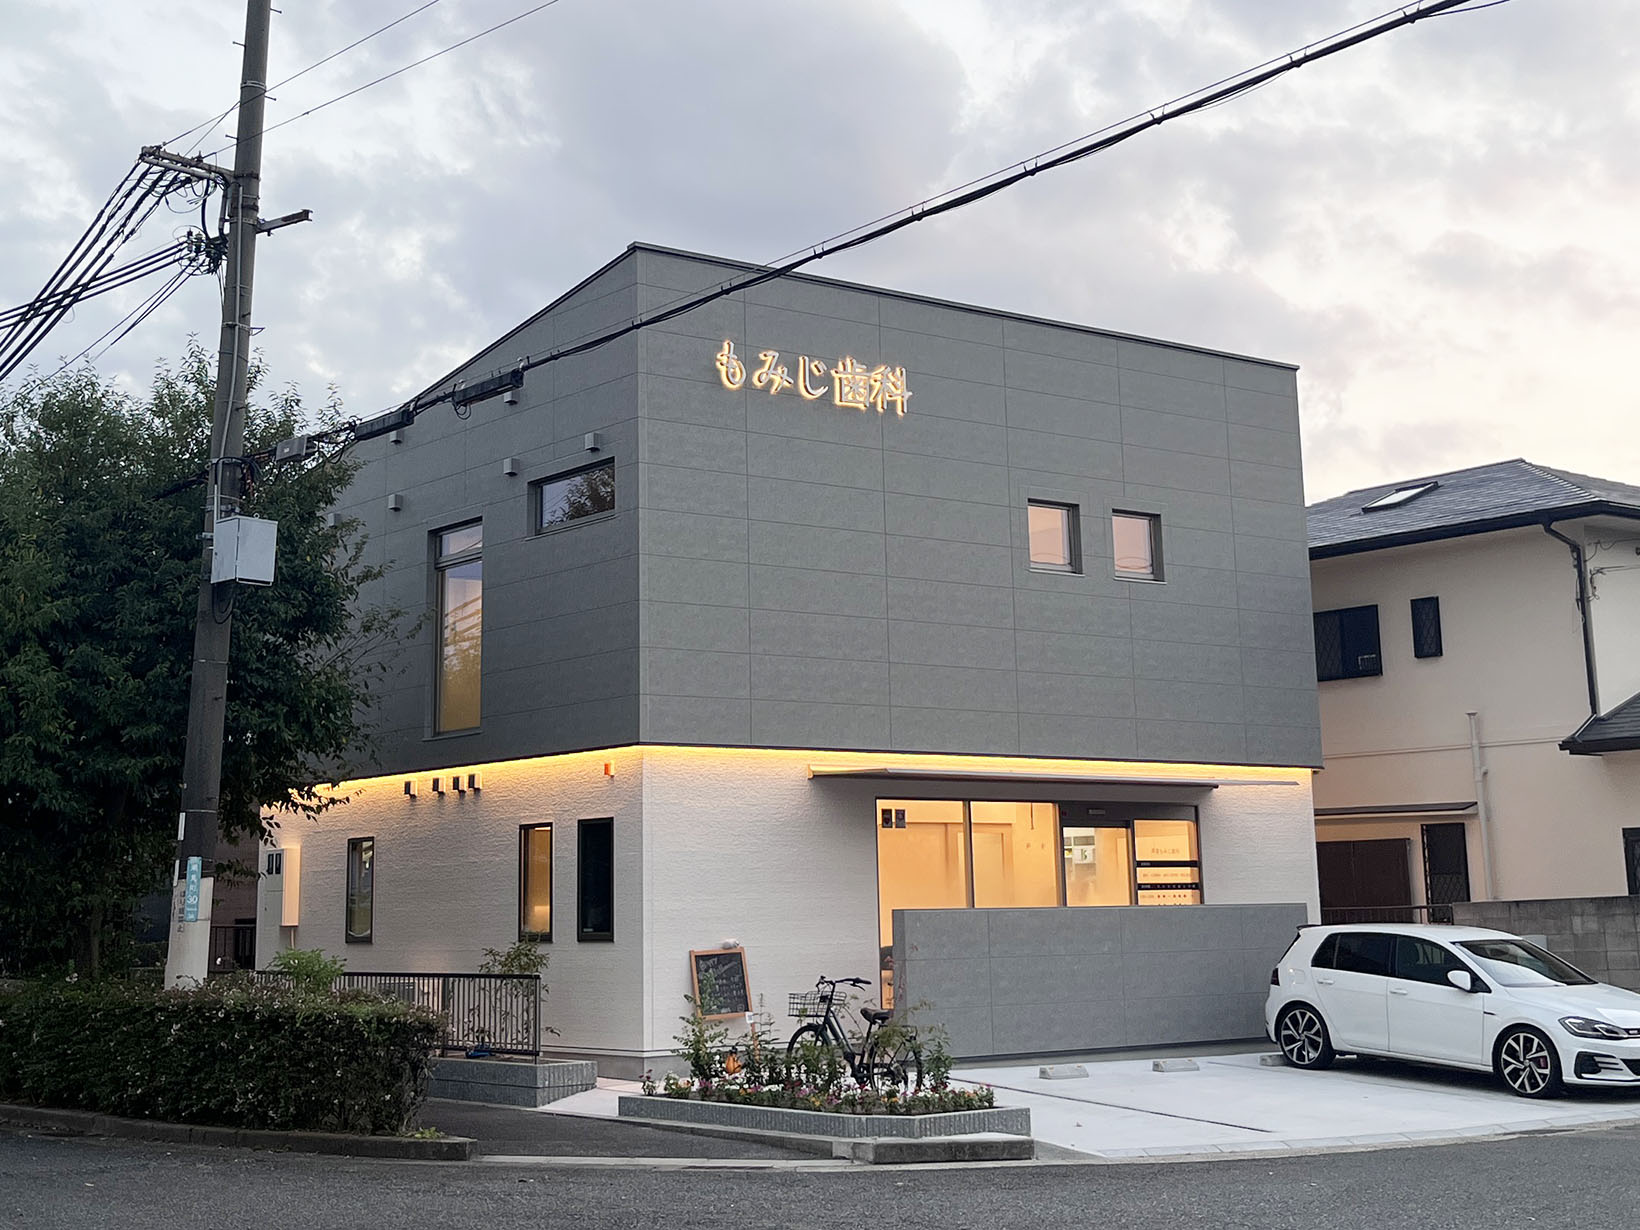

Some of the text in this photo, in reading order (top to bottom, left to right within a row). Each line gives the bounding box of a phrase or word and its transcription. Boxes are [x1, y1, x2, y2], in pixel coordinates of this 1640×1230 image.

[716, 340, 913, 416] もみじ歯科
